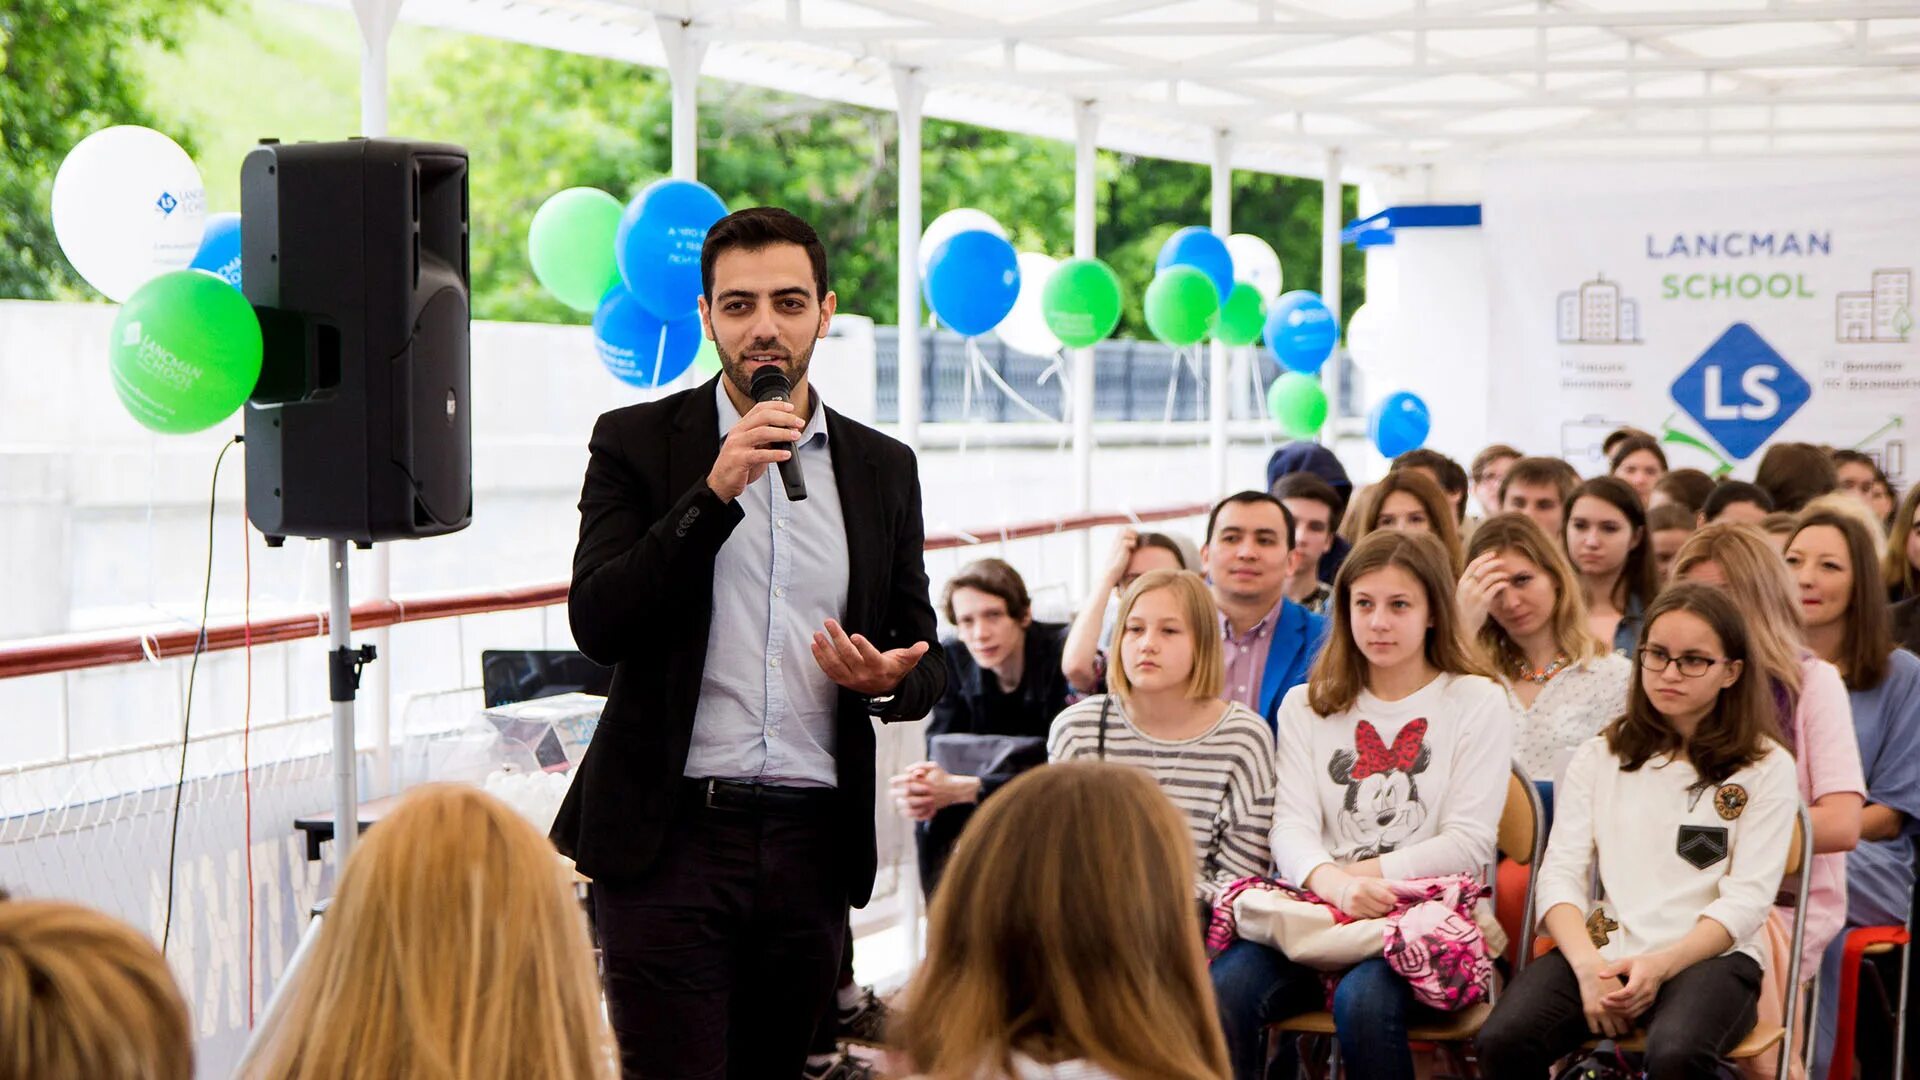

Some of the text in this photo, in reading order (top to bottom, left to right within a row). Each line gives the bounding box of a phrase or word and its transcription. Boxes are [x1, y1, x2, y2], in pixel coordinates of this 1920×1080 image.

[1645, 231, 1831, 259] LANCMAN
[1662, 272, 1816, 299] SCHOOL
[139, 333, 204, 379] LANCMAN
[1703, 363, 1780, 421] LS
